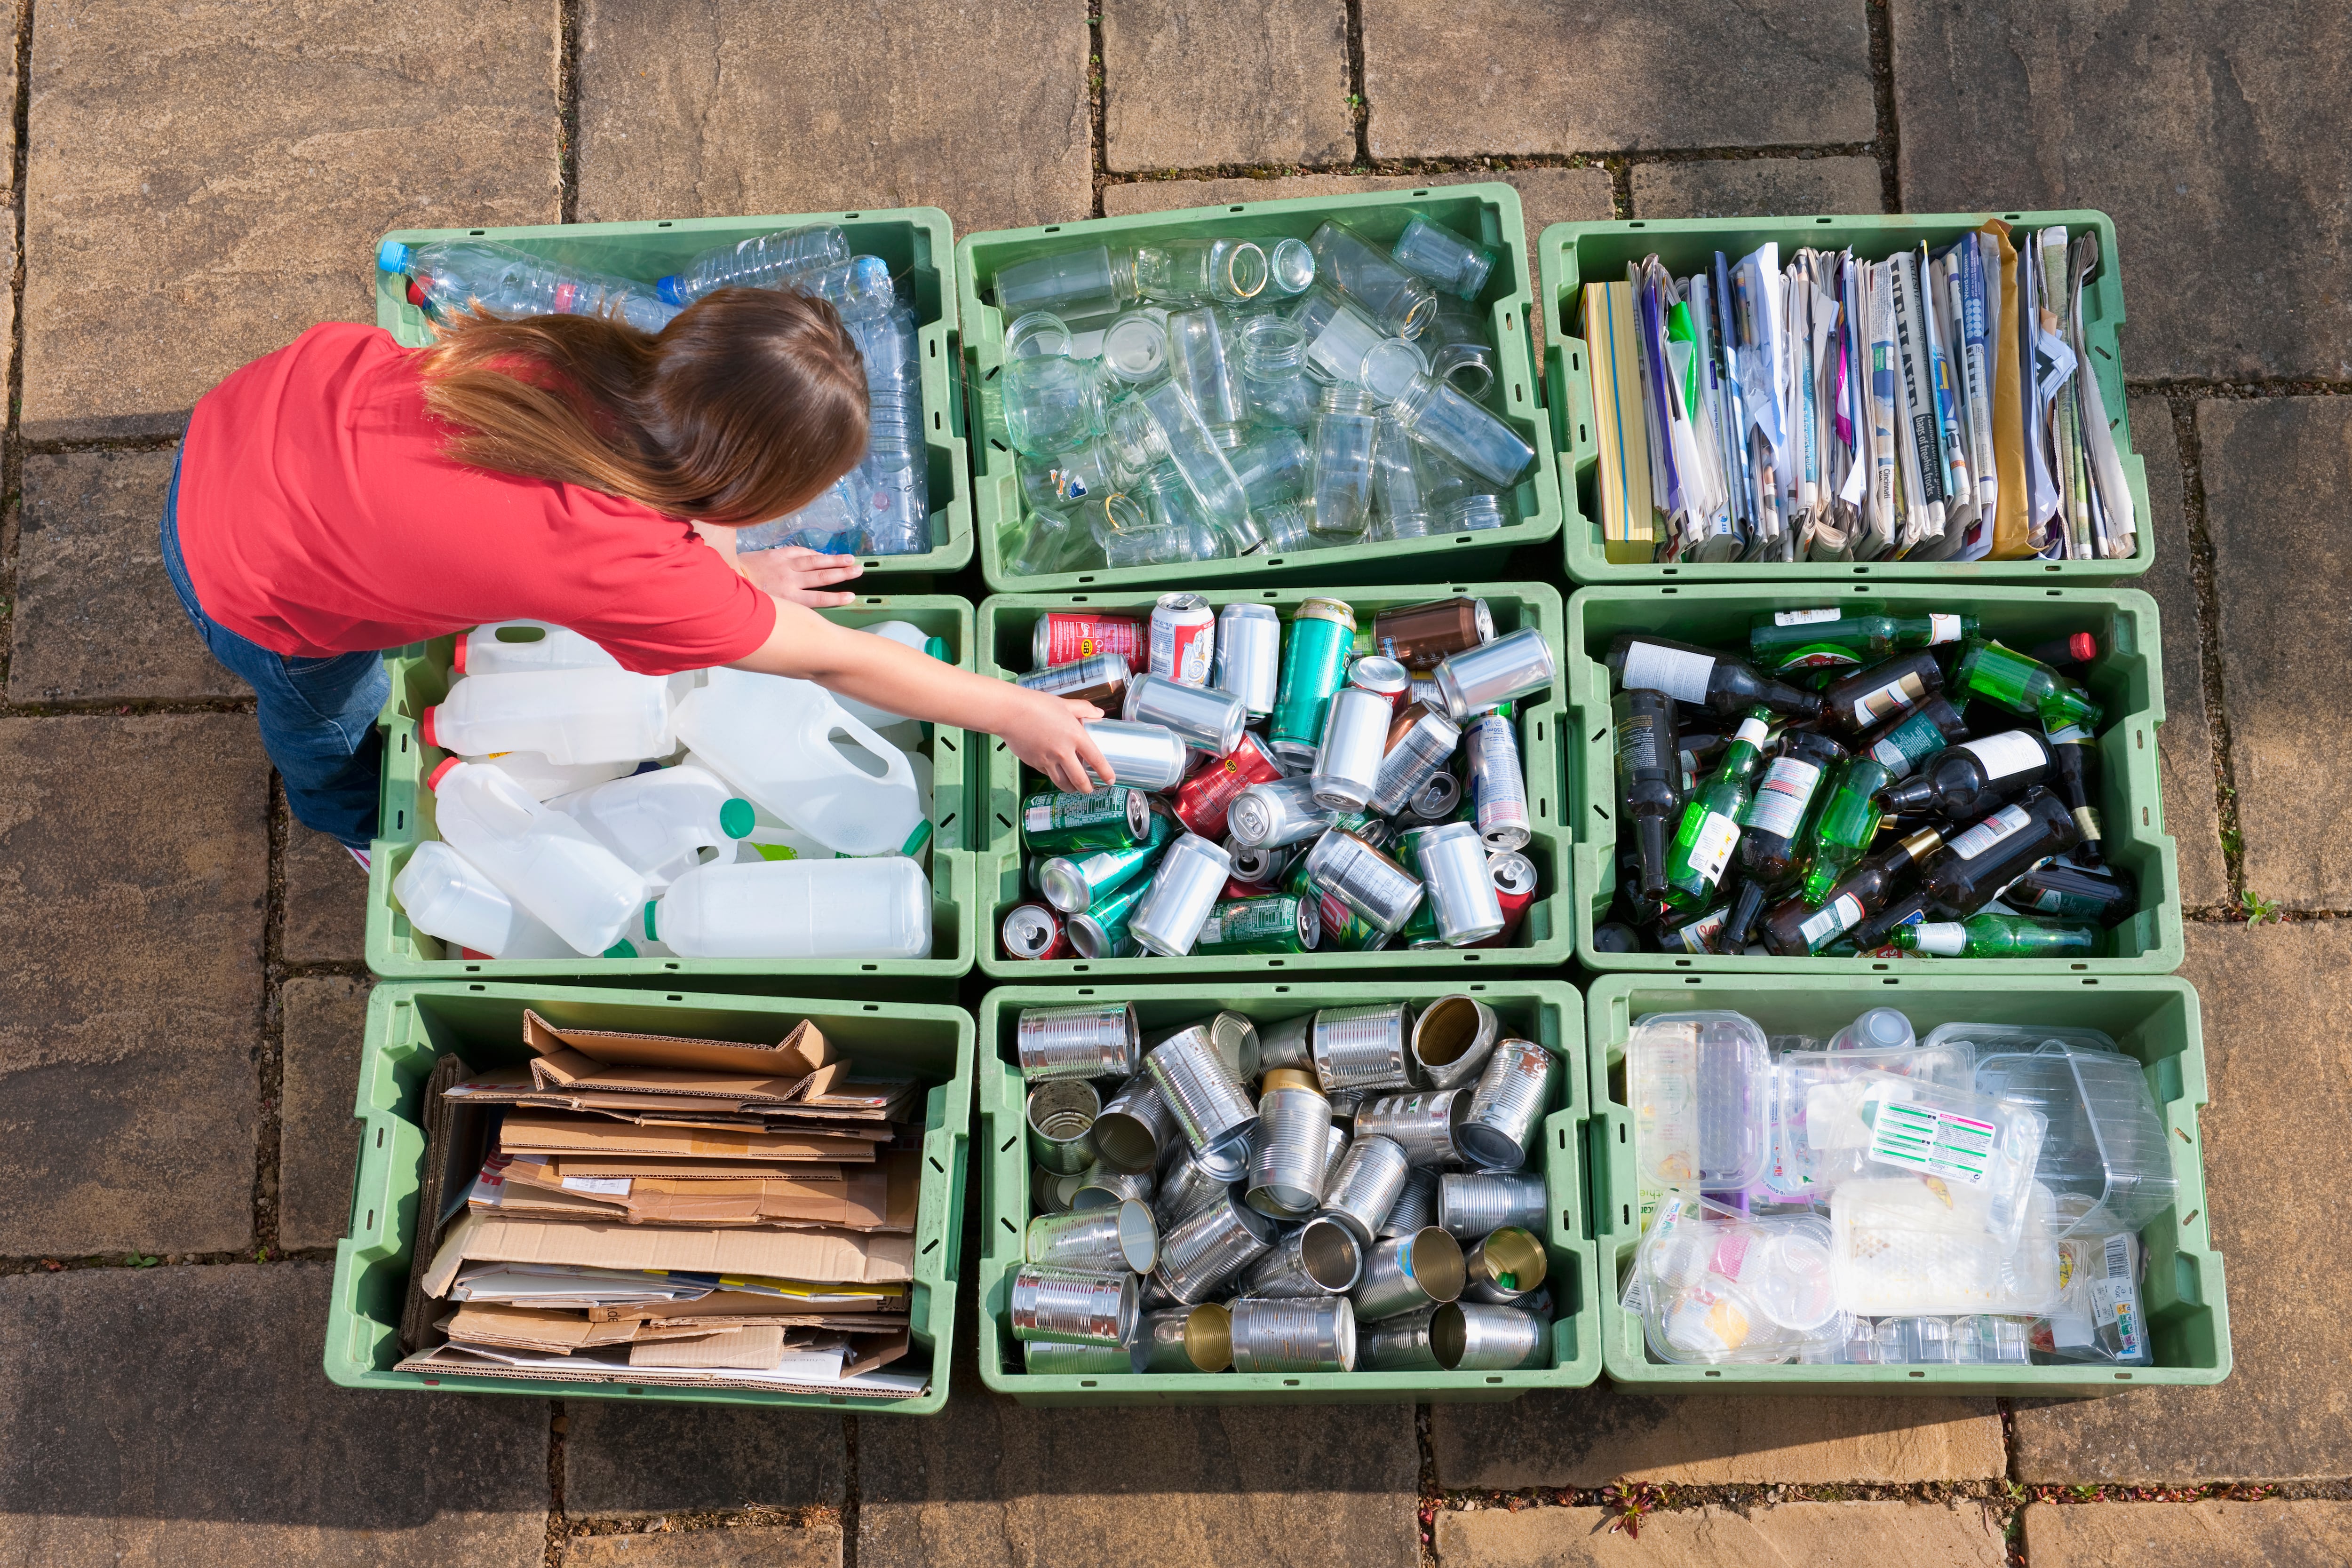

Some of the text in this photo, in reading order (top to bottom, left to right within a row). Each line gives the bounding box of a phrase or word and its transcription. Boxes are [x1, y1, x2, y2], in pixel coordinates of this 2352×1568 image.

[1962, 253, 1970, 278] Square
[1908, 258, 1920, 301] EXCLUSIVE:
[1914, 301, 1925, 343] Astonishing
[1914, 416, 1928, 436] bags
[1917, 435, 1928, 444] of
[1923, 472, 1936, 497] frocks
[1722, 523, 1727, 532] BT
[1083, 641, 1089, 654] GB
